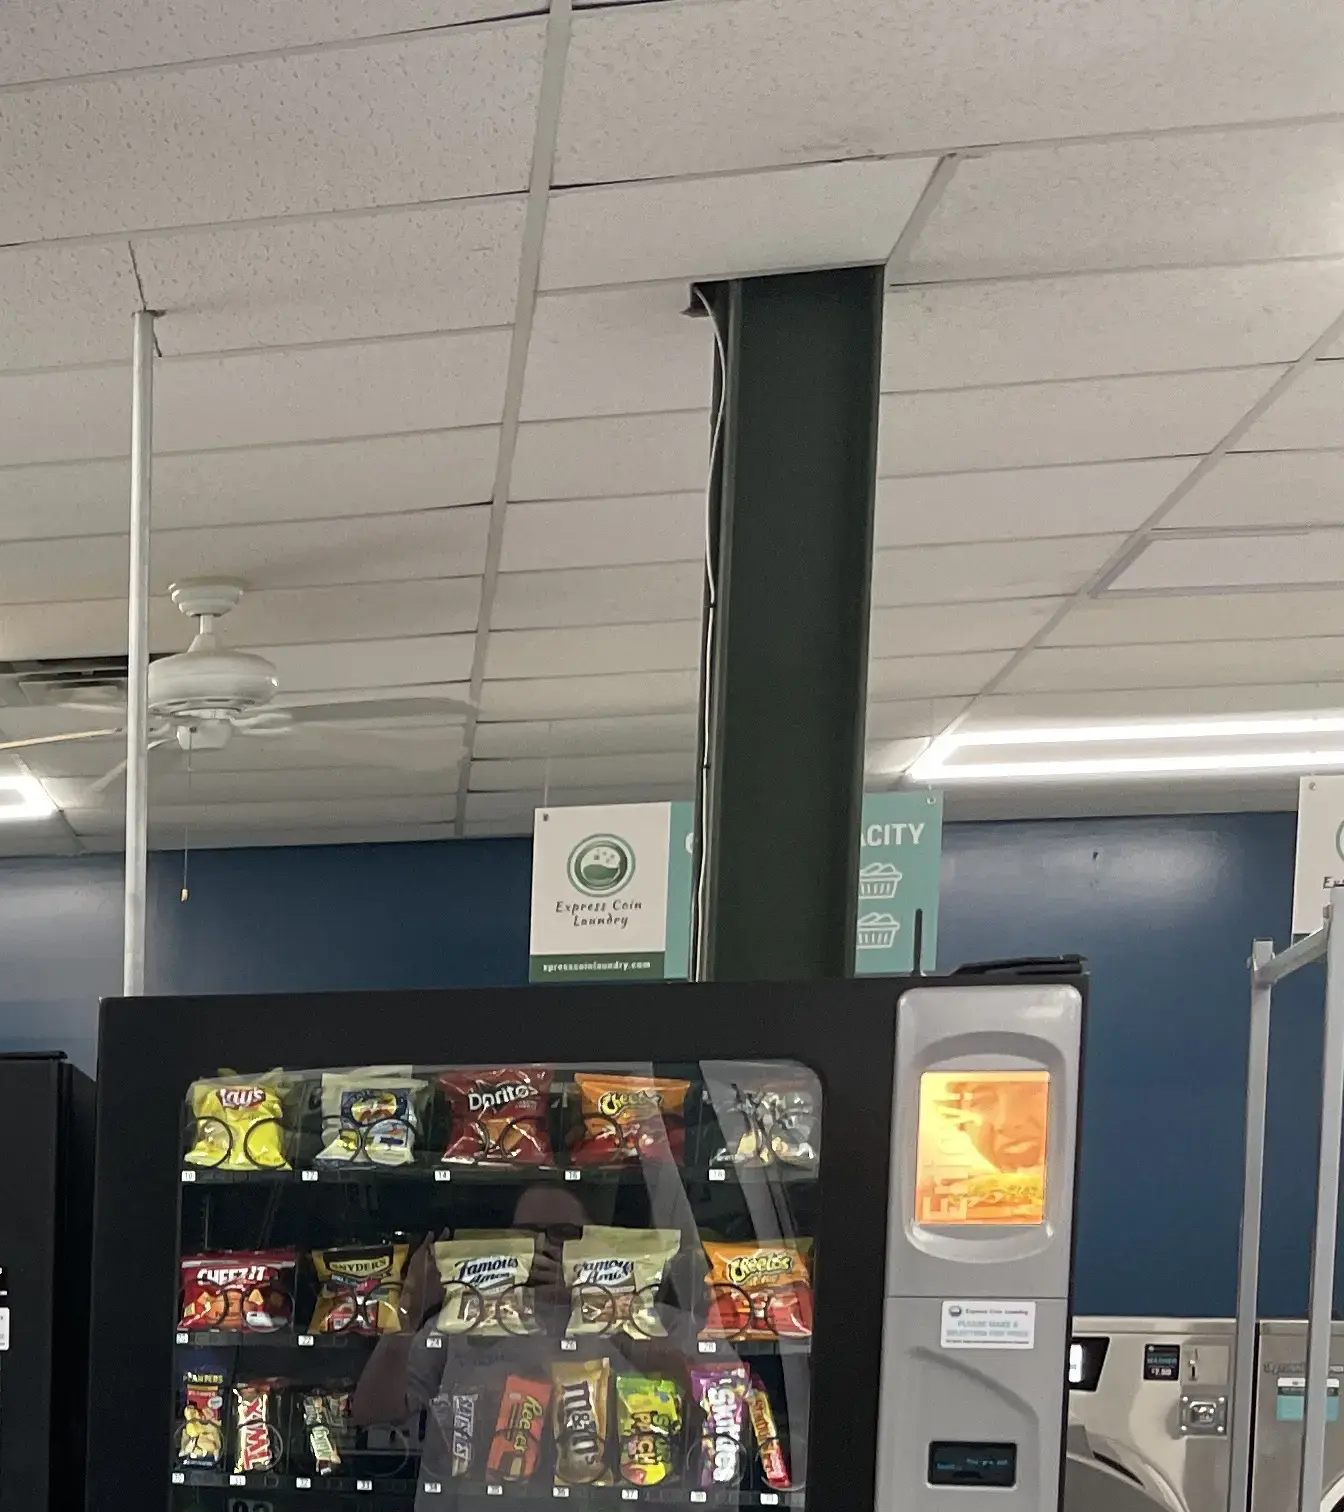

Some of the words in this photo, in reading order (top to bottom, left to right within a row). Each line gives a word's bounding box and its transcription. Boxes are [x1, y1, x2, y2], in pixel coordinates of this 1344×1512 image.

[555, 899, 606, 915] Express
[612, 898, 642, 912] Coin
[572, 913, 629, 929] Laundry
[219, 1086, 264, 1107] Lay's
[469, 1081, 539, 1111] Doritos
[455, 1256, 519, 1277] Famous
[728, 1252, 793, 1283] Cheetos
